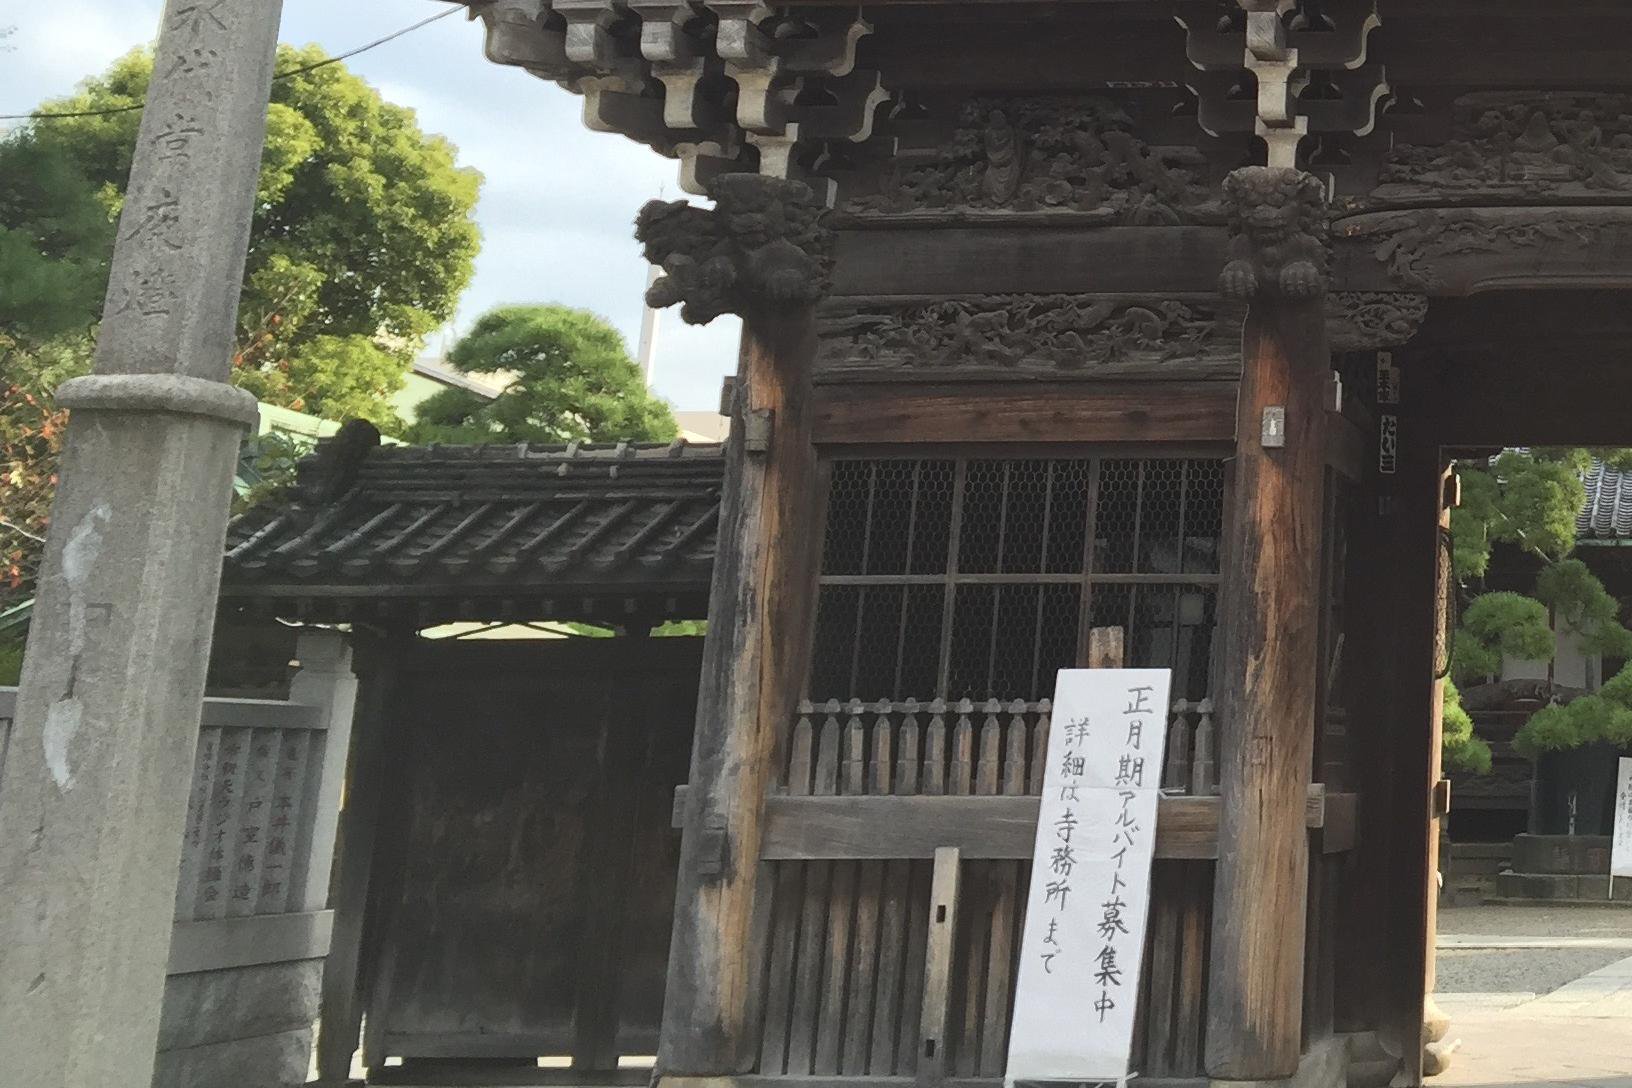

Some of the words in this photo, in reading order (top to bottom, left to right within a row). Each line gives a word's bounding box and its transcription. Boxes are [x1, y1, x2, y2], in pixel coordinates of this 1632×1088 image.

[1039, 716, 1091, 975] 詳細は寺務所まで
[1093, 685, 1154, 1023] 正月期アルバイト募集中
